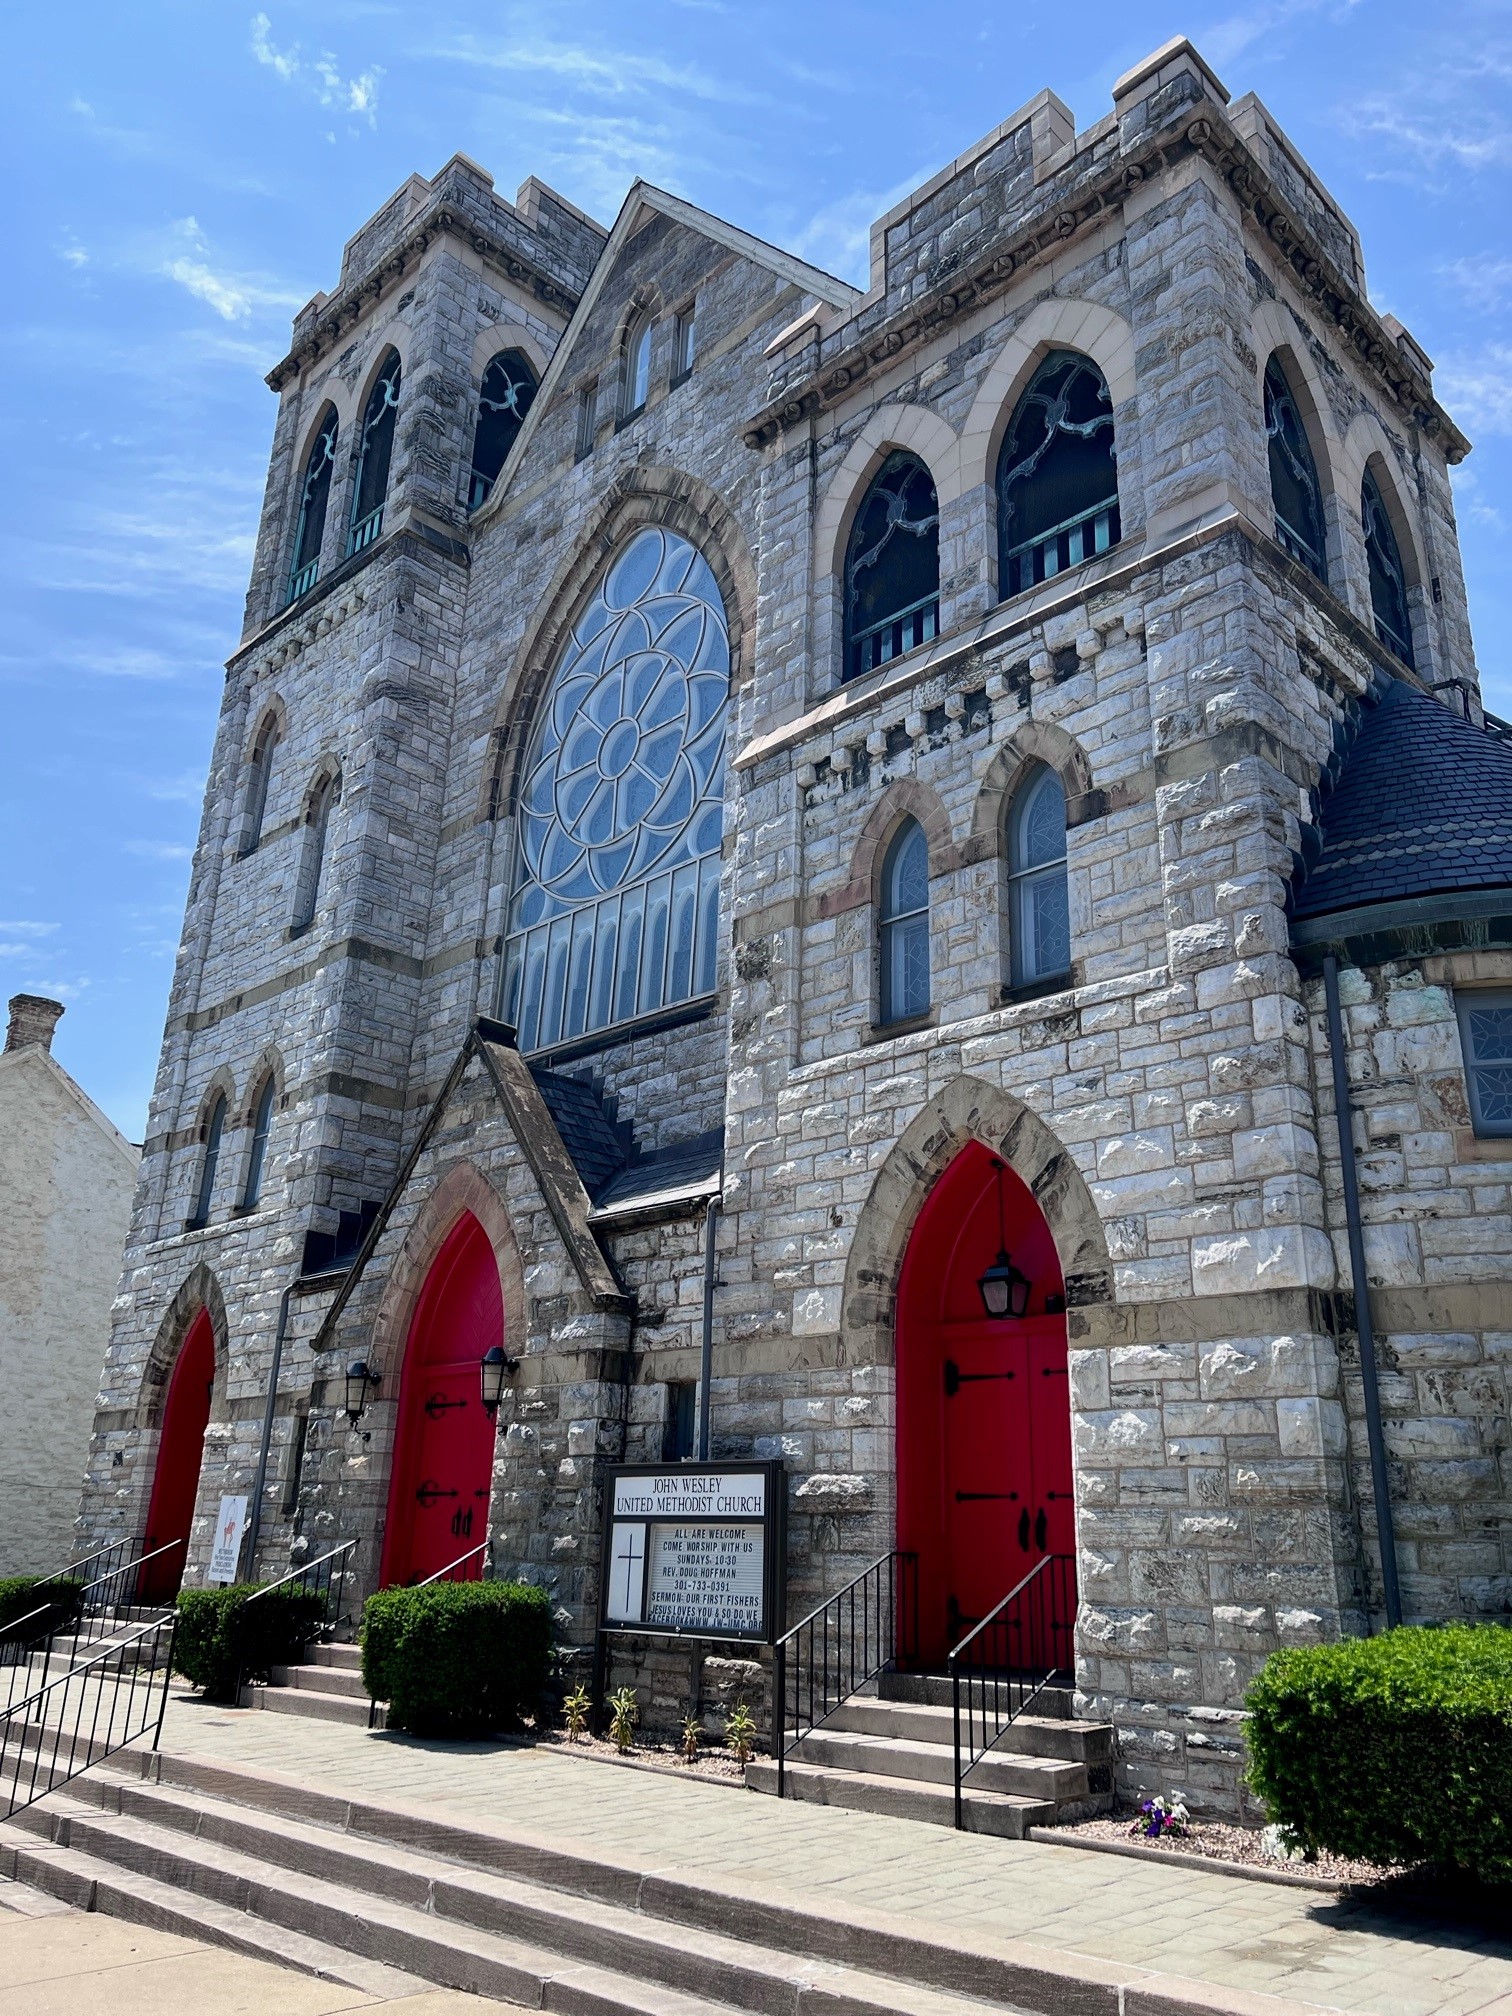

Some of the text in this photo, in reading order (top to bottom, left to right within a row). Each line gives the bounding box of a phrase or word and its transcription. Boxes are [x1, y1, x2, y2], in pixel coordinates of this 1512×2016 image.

[652, 1478, 722, 1494] JOHN WESLEY
[617, 1496, 761, 1512] UNITED METHODIST CHURCH
[675, 1529, 746, 1539] ALL ARE WELCOME
[663, 1541, 753, 1552] COME WORSHIP WITH US
[715, 1555, 737, 1565] 10:30
[663, 1567, 736, 1579] REV. DOUG HOFFMAN
[674, 1580, 730, 1592] 301-733-0391
[686, 1593, 700, 1604] OUR
[703, 1594, 723, 1605] FIRST
[726, 1596, 759, 1607] FISHERS
[651, 1605, 758, 1621] JESUS LOVES YOU & SO DO WE
